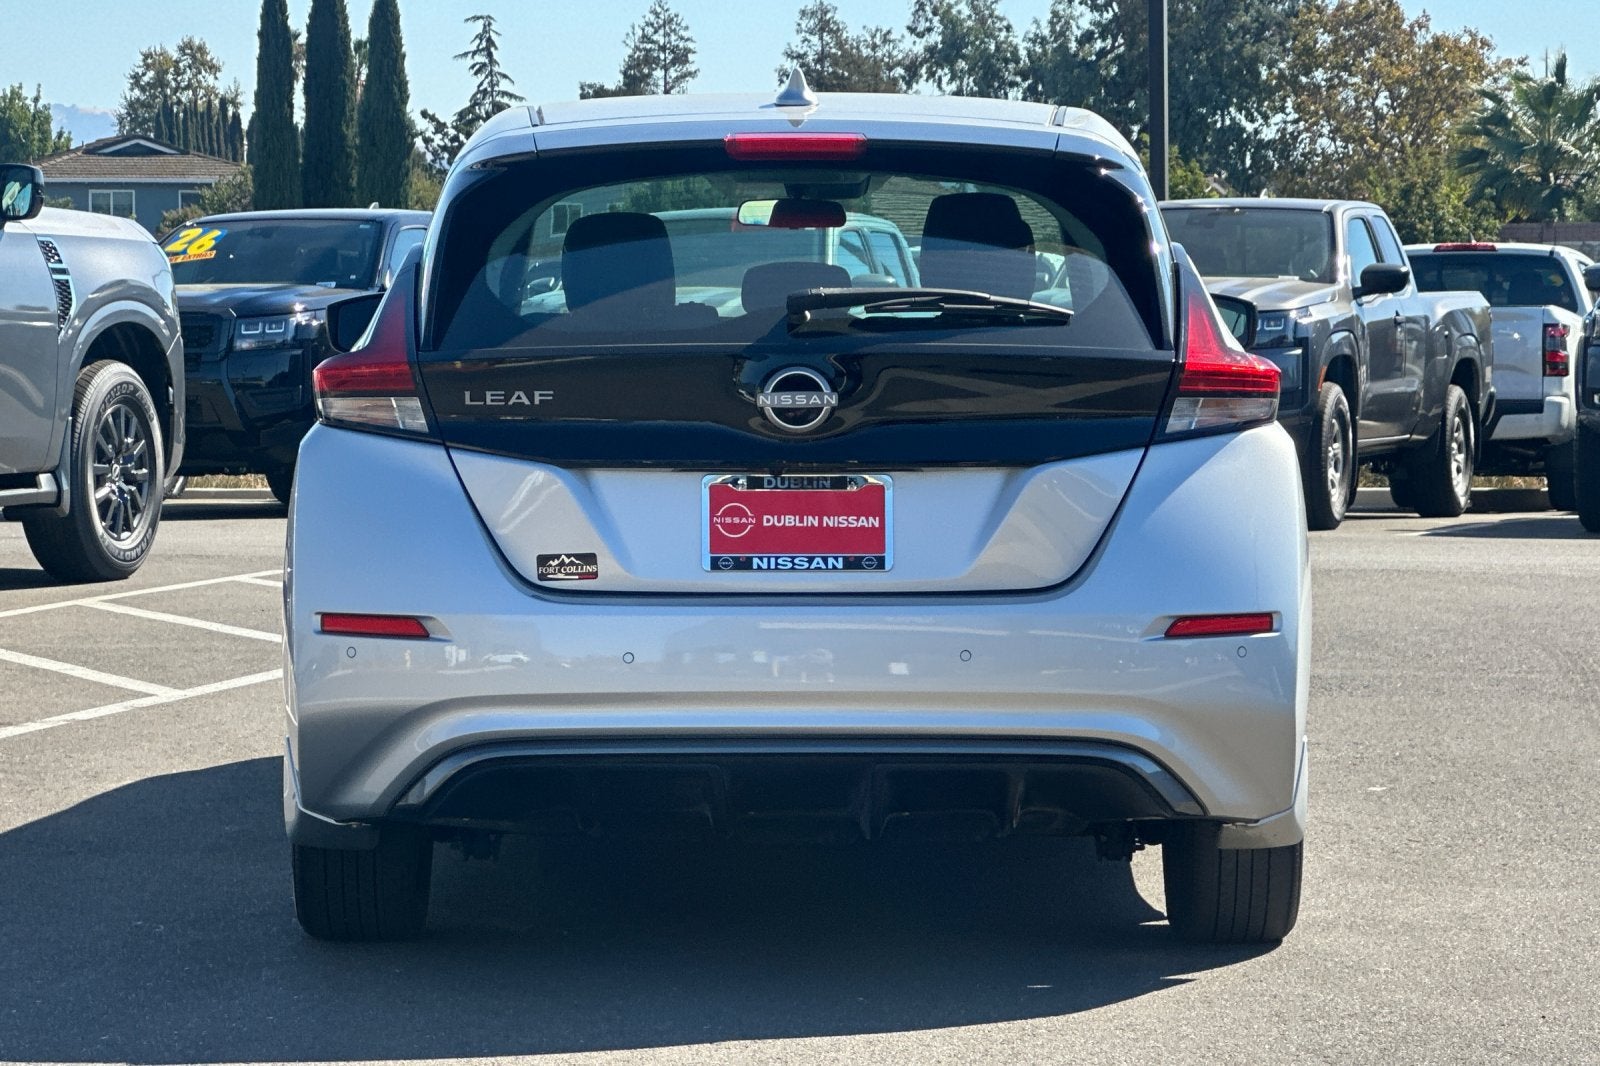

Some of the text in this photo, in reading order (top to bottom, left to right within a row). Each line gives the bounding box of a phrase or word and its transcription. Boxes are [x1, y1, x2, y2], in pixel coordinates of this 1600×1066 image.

[165, 228, 222, 255] 26
[464, 390, 554, 405] LEAF
[758, 394, 837, 406] NISSAN
[763, 475, 831, 489] DUBLIN
[713, 516, 756, 524] NISSAN
[762, 515, 880, 528] DUBLIN NISSAN
[538, 564, 598, 574] FORT COLLINS
[752, 556, 844, 570] NISSAN
